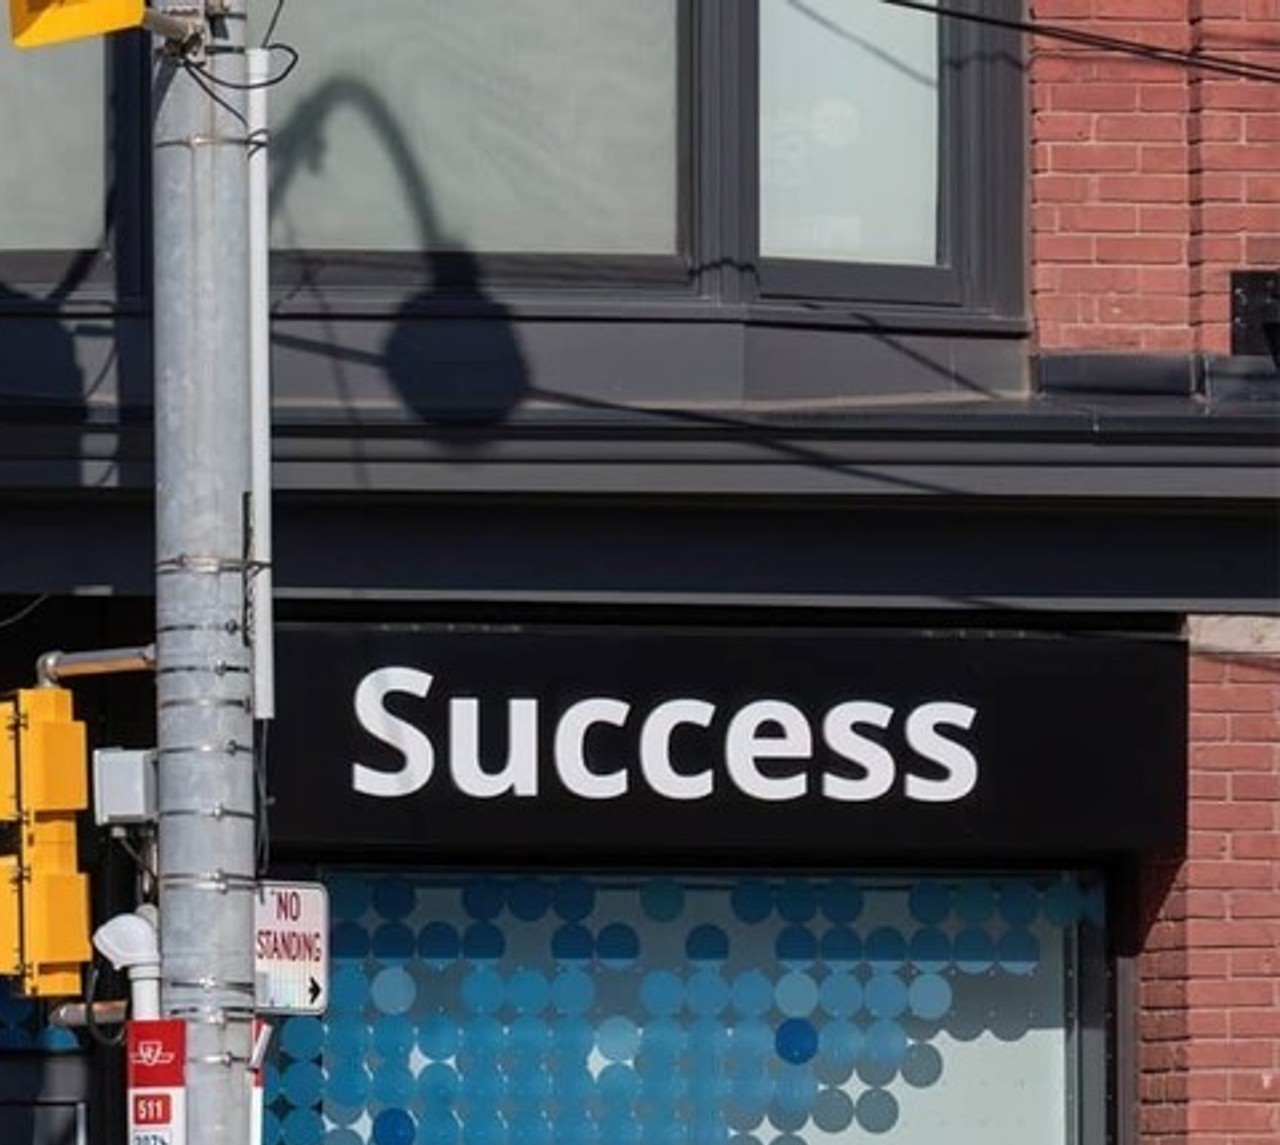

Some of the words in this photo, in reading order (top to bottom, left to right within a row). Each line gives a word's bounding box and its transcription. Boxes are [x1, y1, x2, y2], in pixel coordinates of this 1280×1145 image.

[351, 665, 980, 803] Success
[276, 890, 301, 922] NO
[257, 929, 322, 962] STANDING
[137, 1099, 163, 1121] 511
